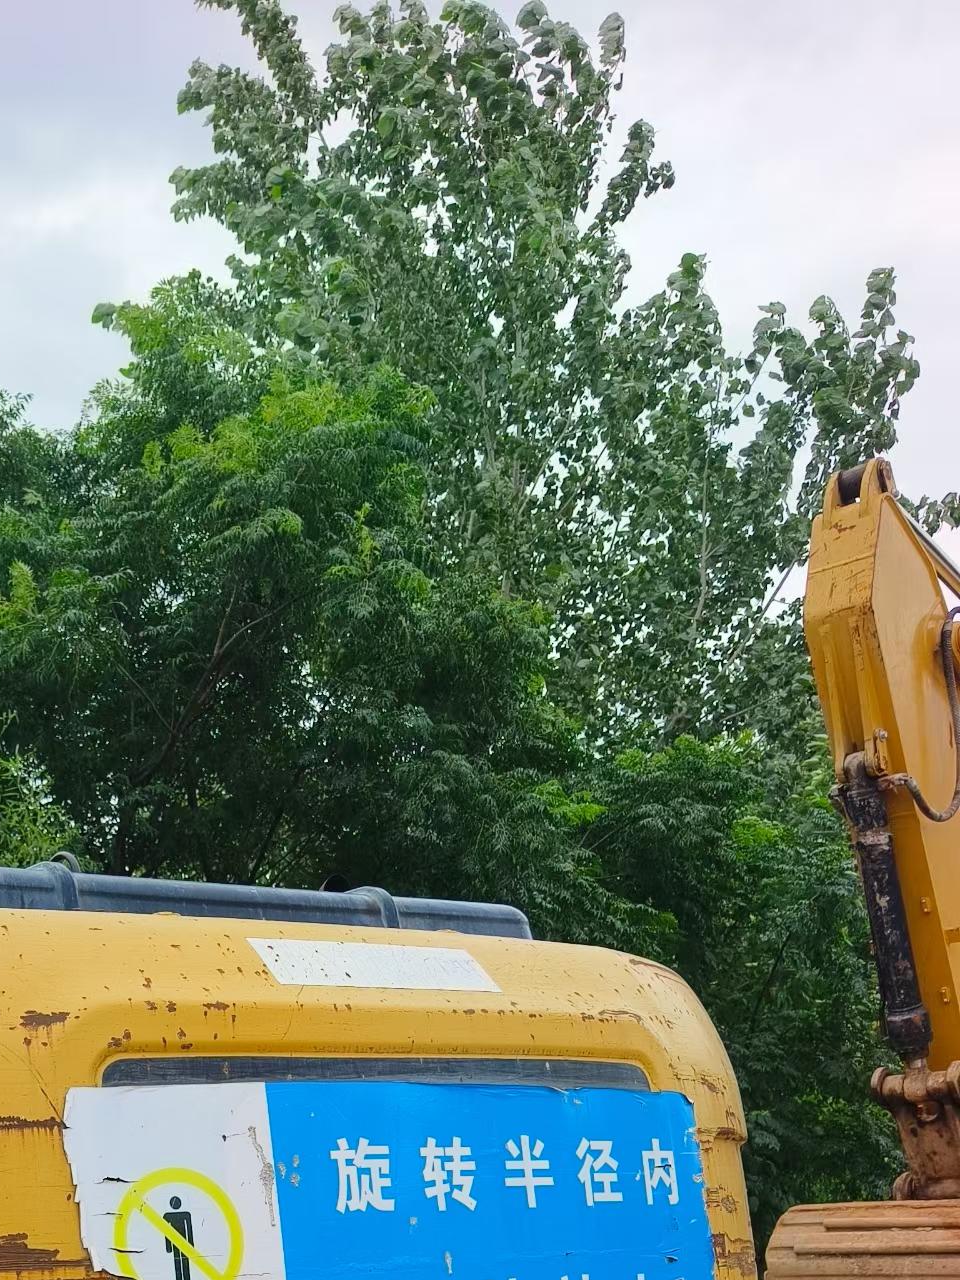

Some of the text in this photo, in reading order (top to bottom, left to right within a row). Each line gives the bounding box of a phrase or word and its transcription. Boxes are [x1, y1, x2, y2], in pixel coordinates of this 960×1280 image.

[330, 1134, 680, 1214] 旋转半径内
